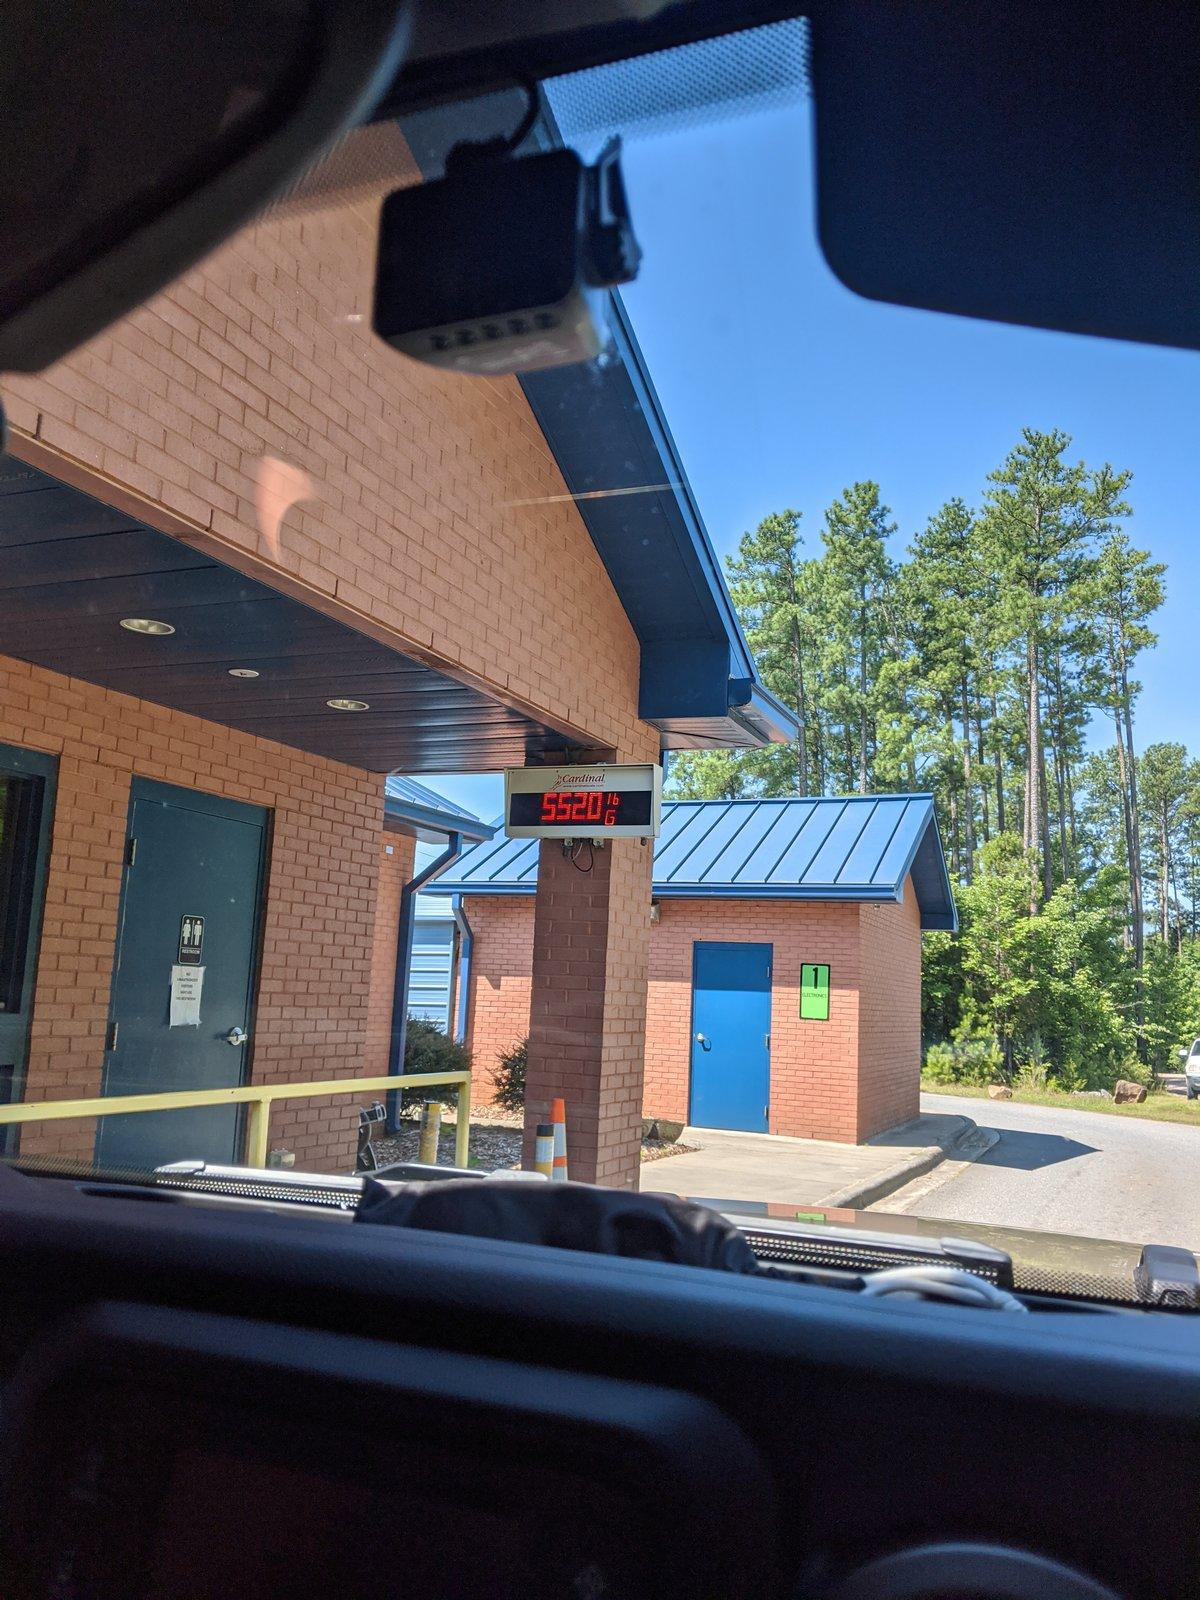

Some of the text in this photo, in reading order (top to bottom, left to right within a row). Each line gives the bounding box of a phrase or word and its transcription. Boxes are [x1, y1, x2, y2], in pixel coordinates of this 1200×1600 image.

[562, 773, 605, 783] Cardinal
[541, 792, 603, 820] 5520
[604, 810, 616, 826] G
[812, 967, 818, 989] 1
